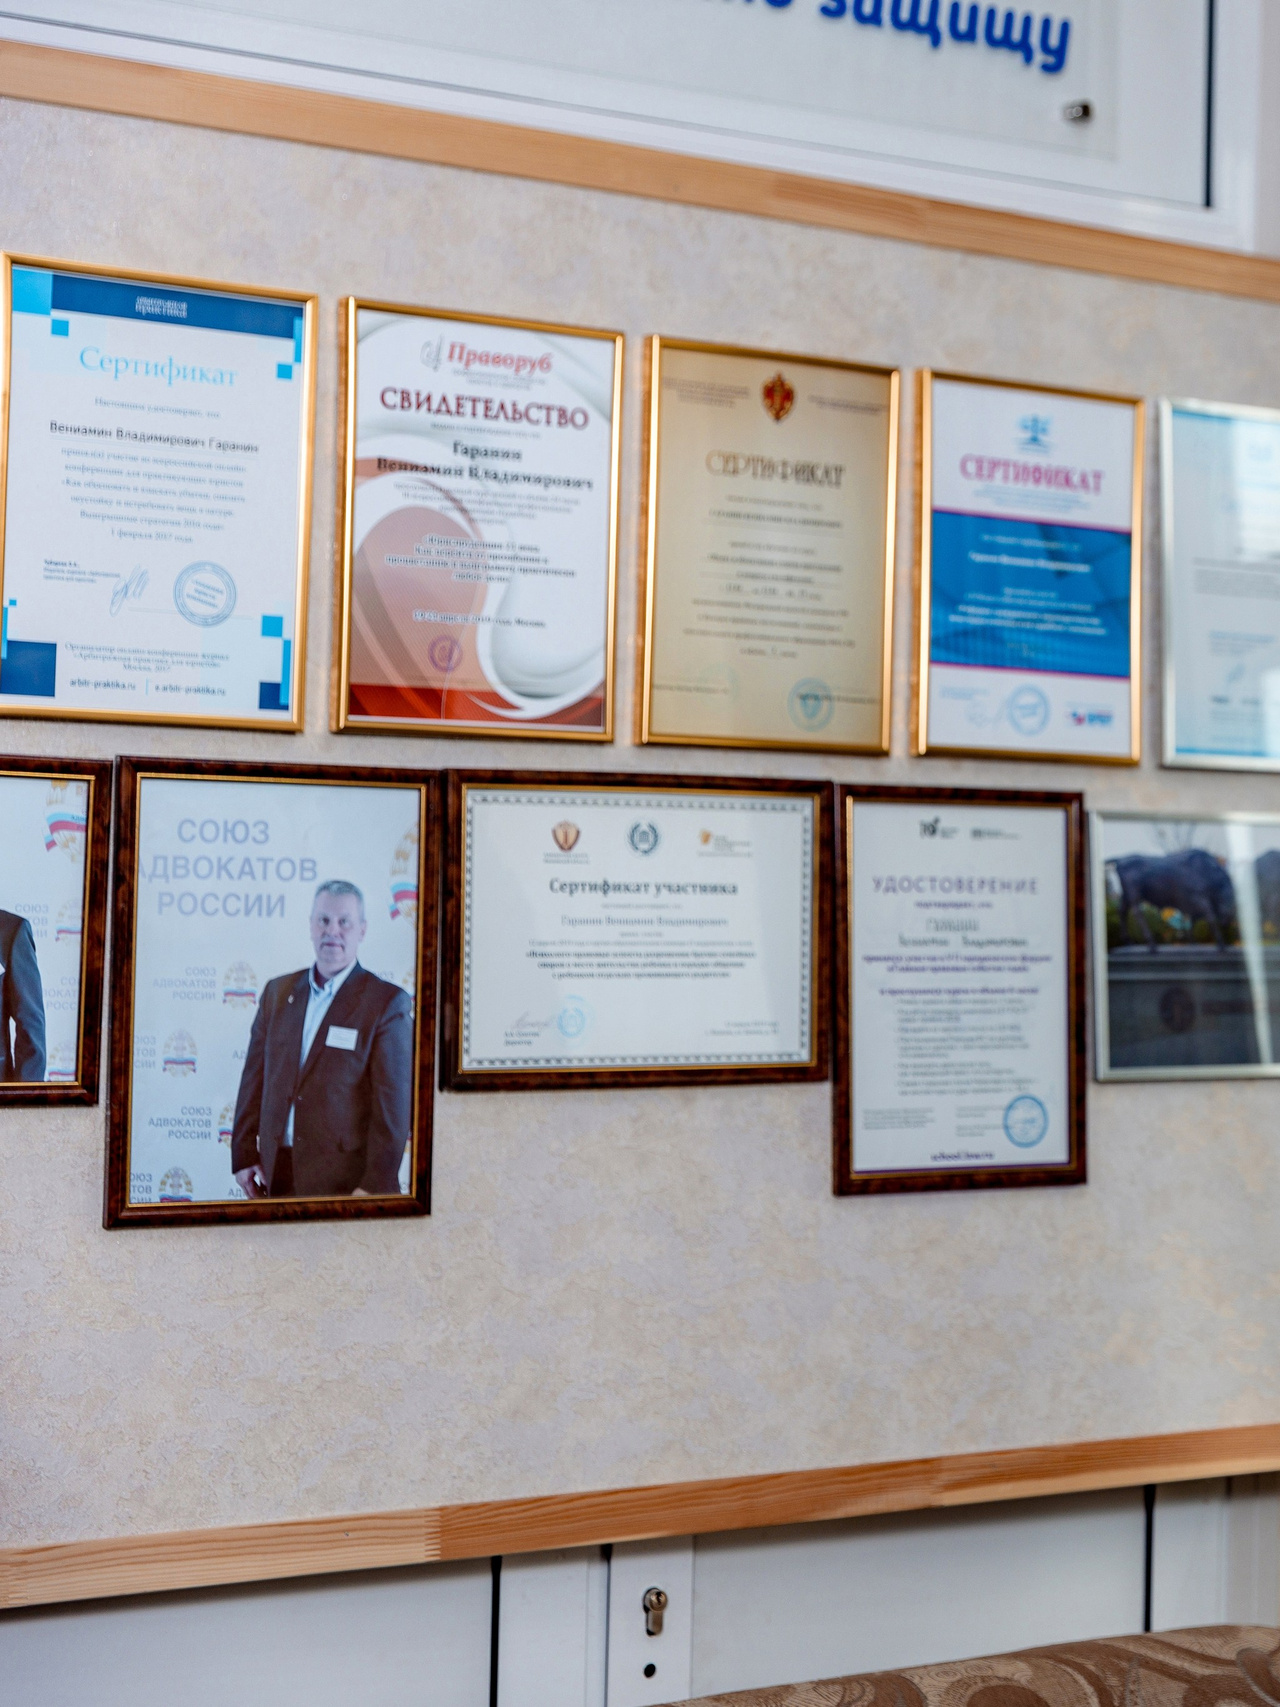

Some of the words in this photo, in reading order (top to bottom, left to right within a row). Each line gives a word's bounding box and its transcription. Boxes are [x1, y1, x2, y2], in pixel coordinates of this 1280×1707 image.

[80, 345, 238, 386] Сертификат
[447, 341, 553, 375] Праворуб
[379, 385, 590, 431] СВИДЕТЕЛЬСТВО
[50, 420, 112, 438] Вениамин
[116, 429, 204, 448] Владимирович
[209, 437, 259, 454] Гаранин
[453, 440, 522, 461] Гаранин
[377, 457, 465, 477] Вениамин
[469, 467, 593, 491] Владимирович
[705, 449, 845, 489] СЕРТИФИКАТ
[959, 453, 1104, 495] СЕРТИФИКАТ
[177, 818, 270, 845] СОЮЗ
[549, 877, 650, 898] Сертификат
[654, 881, 738, 898] участника
[872, 876, 1038, 896] УДОСТОВЕРЕНИЕ
[157, 891, 286, 918] РОССИИ
[185, 967, 217, 977] СОЮЗ
[153, 978, 216, 989] АДВОКАТОВ
[172, 991, 215, 1000] РОССИИ
[134, 1035, 156, 1045] ОЮЗ
[181, 1106, 212, 1116] СОЮЗ
[149, 1118, 211, 1128] АДВОКАТОВ
[168, 1130, 211, 1140] РОССИИ
[131, 1173, 152, 1182] ОЮЗ
